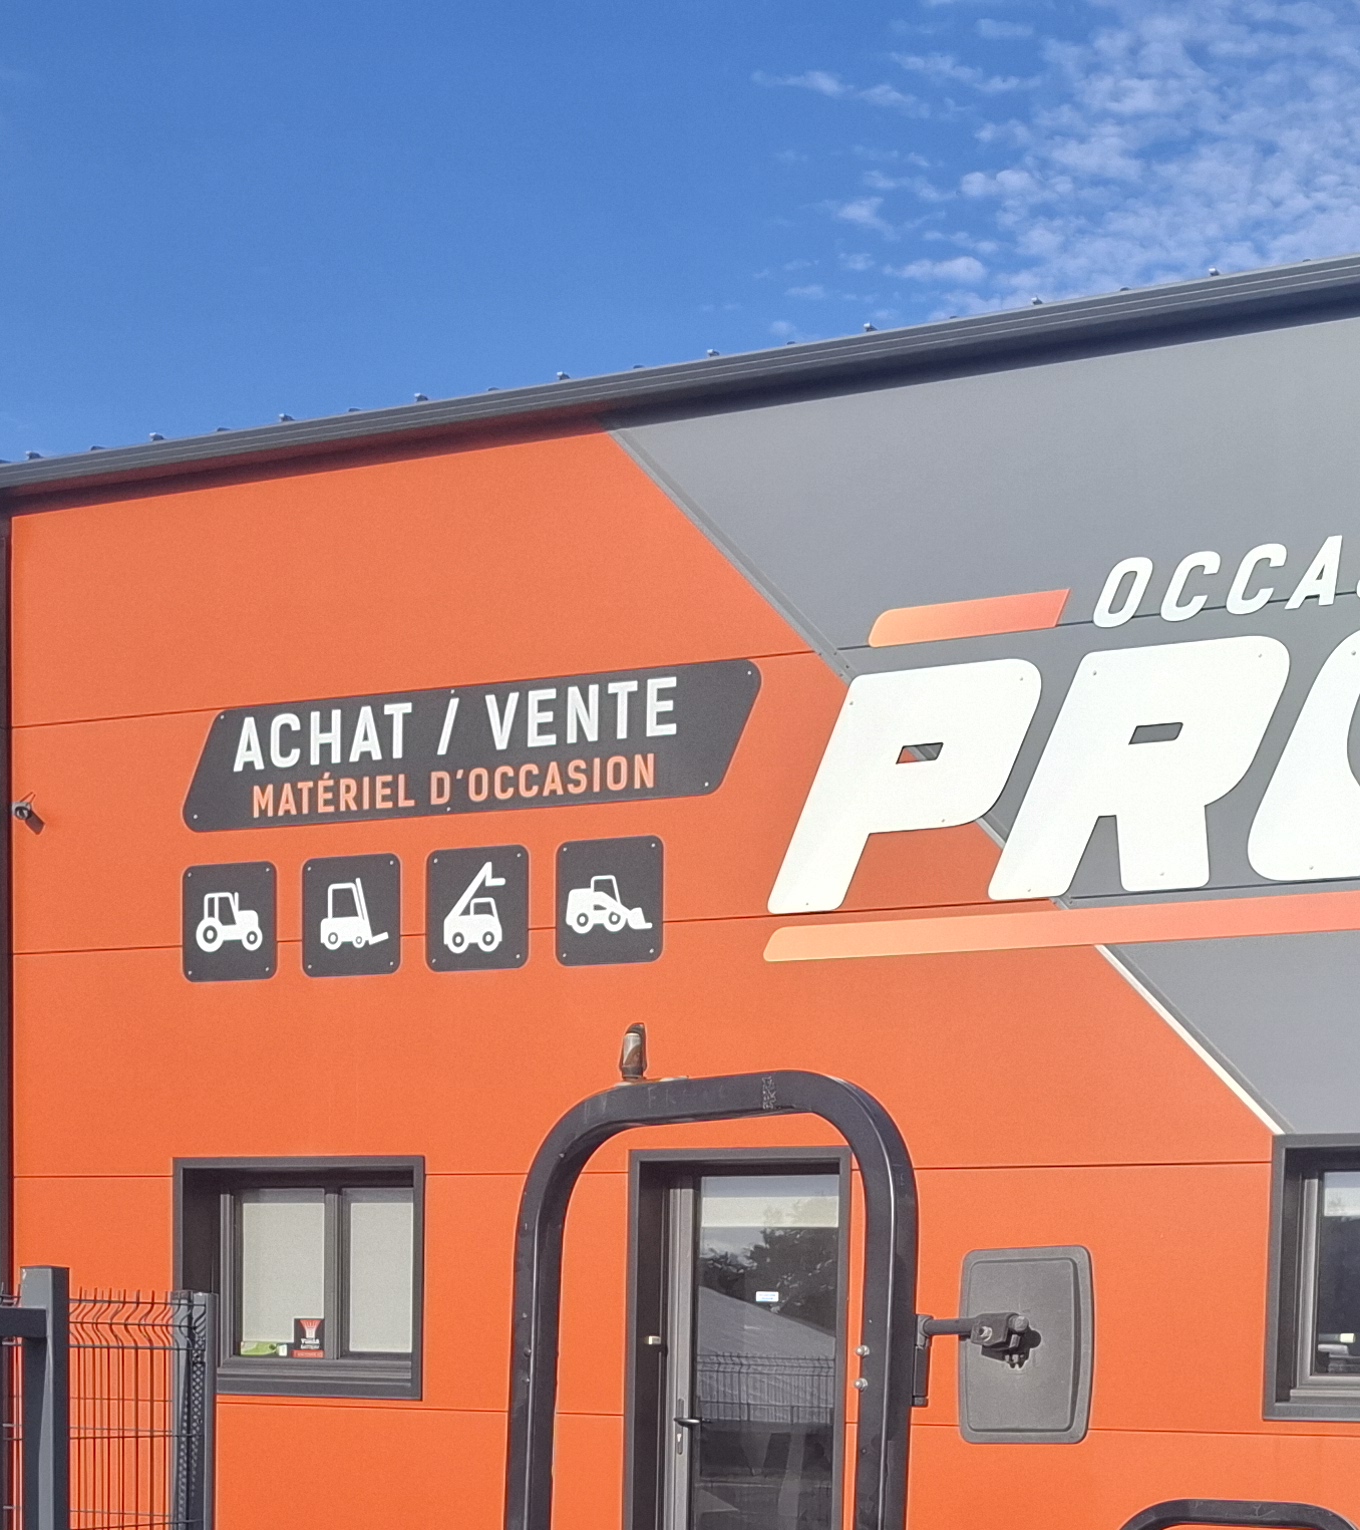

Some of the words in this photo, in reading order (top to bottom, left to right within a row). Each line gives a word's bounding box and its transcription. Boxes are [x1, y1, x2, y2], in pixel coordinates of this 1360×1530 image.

[233, 702, 413, 772] ACHAT
[437, 697, 460, 756] /
[485, 676, 678, 751] VENTE
[252, 772, 416, 818] MATÉRIEL
[430, 752, 656, 806] D'OCCASION
